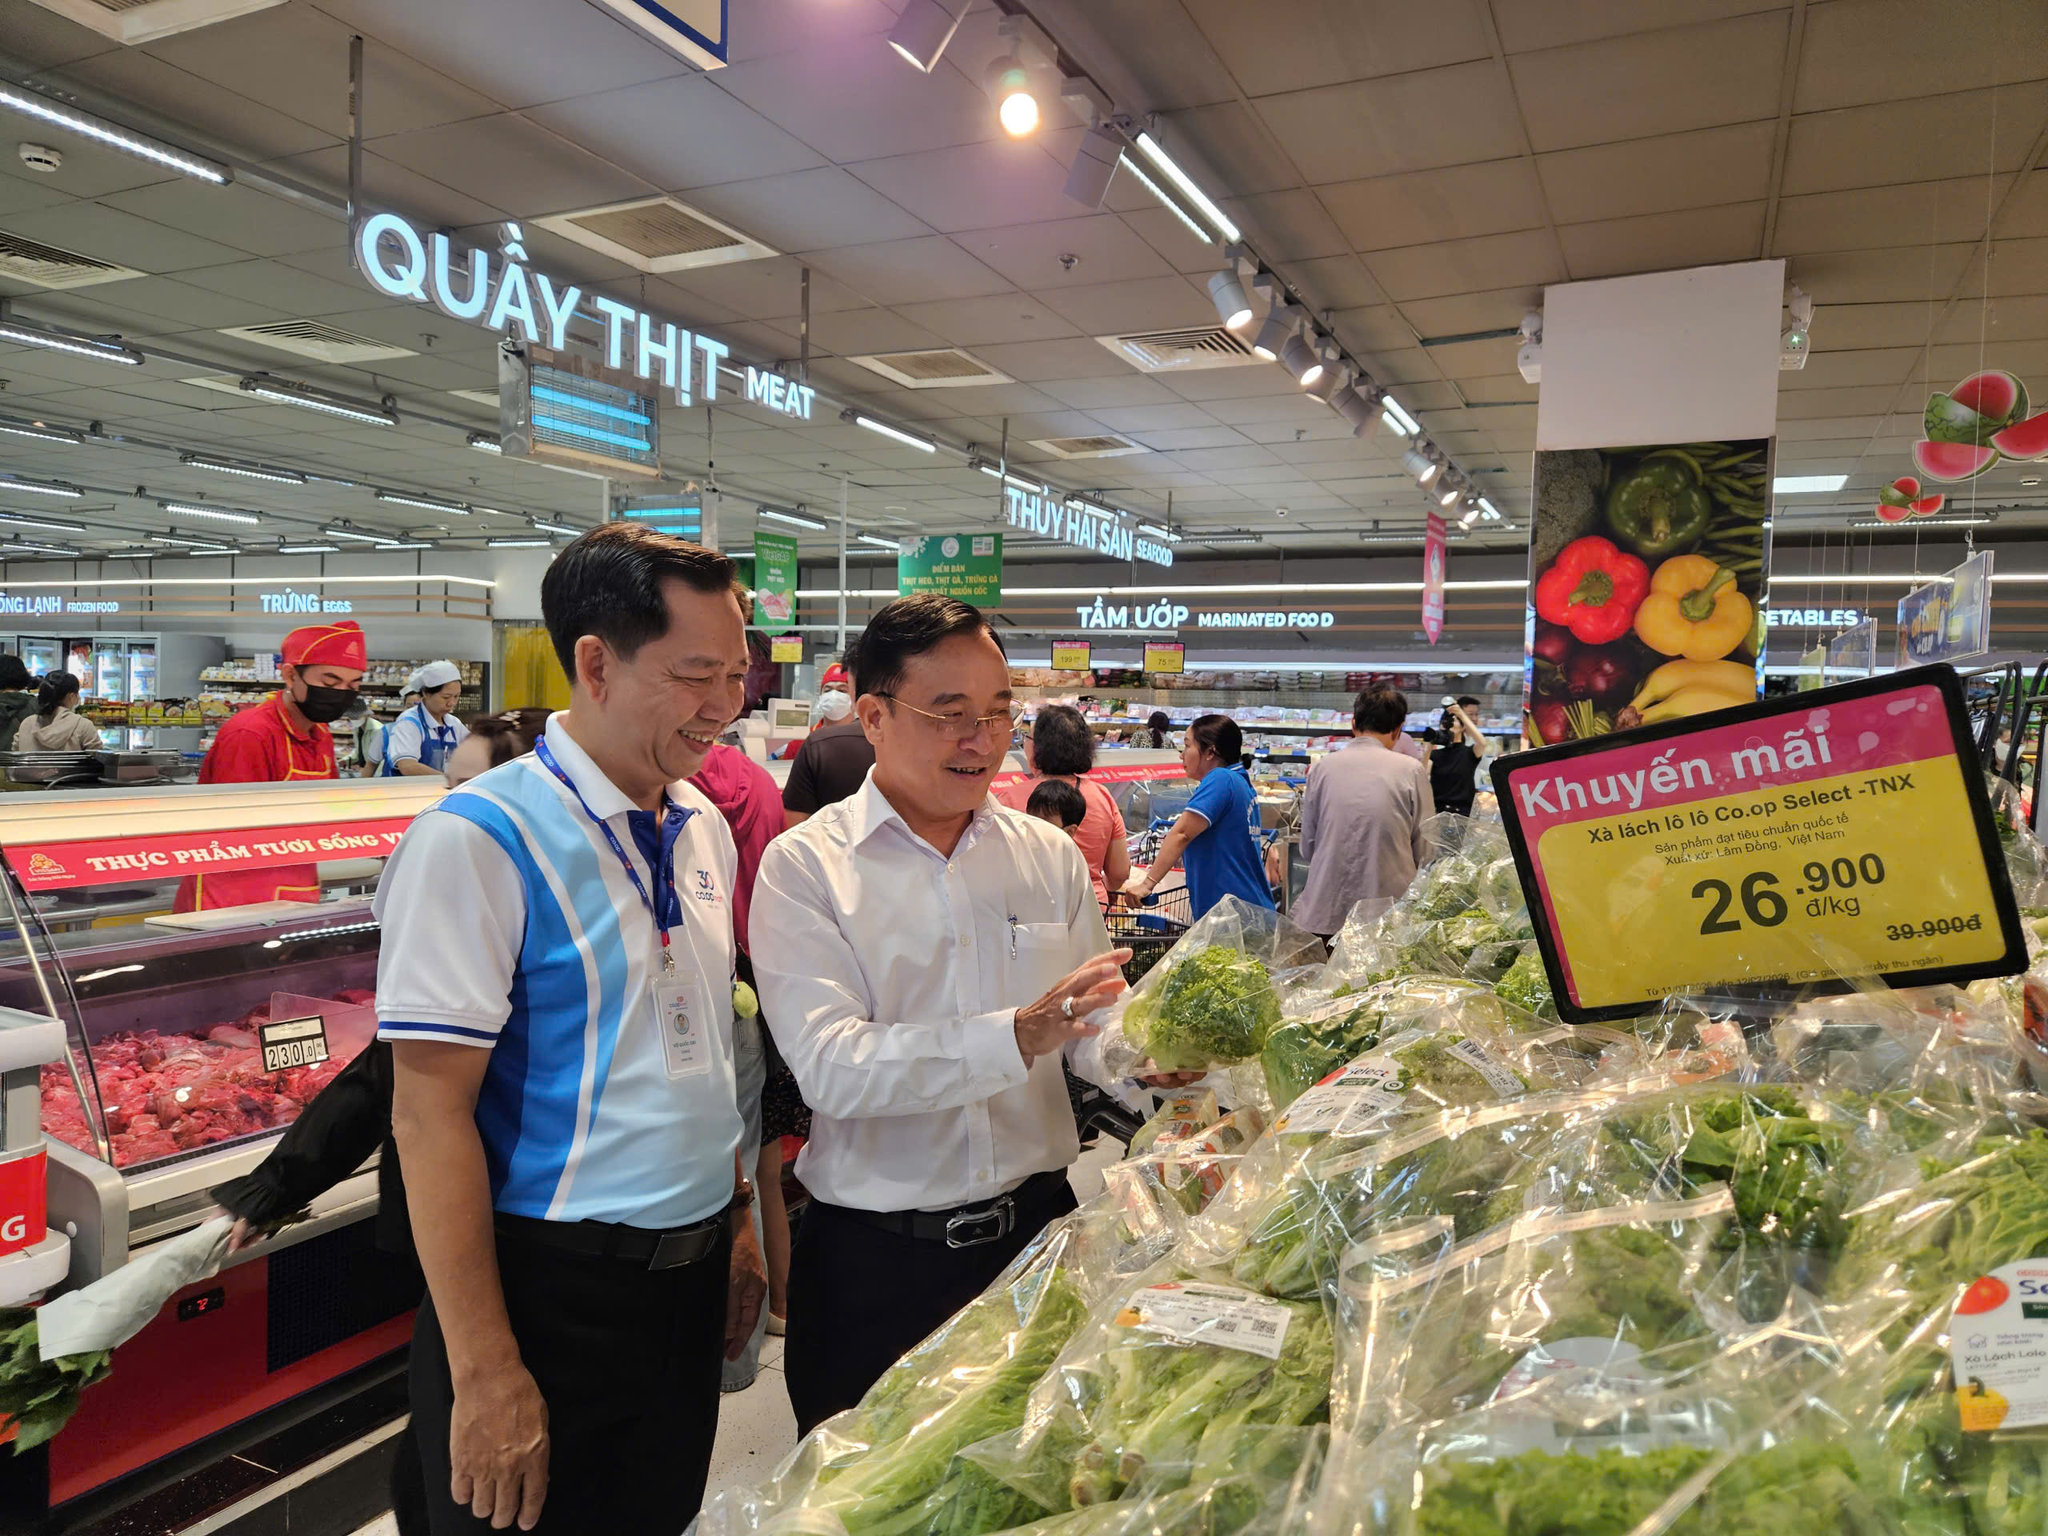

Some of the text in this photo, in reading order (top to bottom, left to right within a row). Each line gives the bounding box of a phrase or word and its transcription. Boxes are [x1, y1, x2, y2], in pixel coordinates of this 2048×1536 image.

[357, 212, 816, 420] QUẦY THỊT MEAT
[1006, 484, 1065, 540] THỦY
[1100, 514, 1134, 562] SẢN
[1135, 537, 1174, 568] SEAFOOD
[26, 596, 62, 617] LẠNH
[67, 602, 97, 613] FROZEN
[97, 602, 120, 613] FOOD
[260, 587, 353, 614] TRỨNG EGGS
[1134, 597, 1189, 629] ƯỚP
[1198, 612, 1287, 628] MARINATED
[1518, 724, 1833, 818] Khuyến mãi
[1587, 773, 1916, 845] Xà lách lô lô Co.op Select -TNX
[86, 851, 171, 872] THỰC
[171, 840, 251, 865] PHẨM
[252, 838, 313, 858] TƯƠI
[317, 832, 380, 853] SỐNG
[1655, 810, 1850, 854] Sản phẩm đạt tiêu chuẩn quốc tế
[1715, 844, 1743, 858] Lâm
[1787, 833, 1813, 848] Việt
[1815, 829, 1846, 843] Nam
[1691, 852, 1886, 935] 26 .900
[1805, 895, 1861, 918] đ/kg
